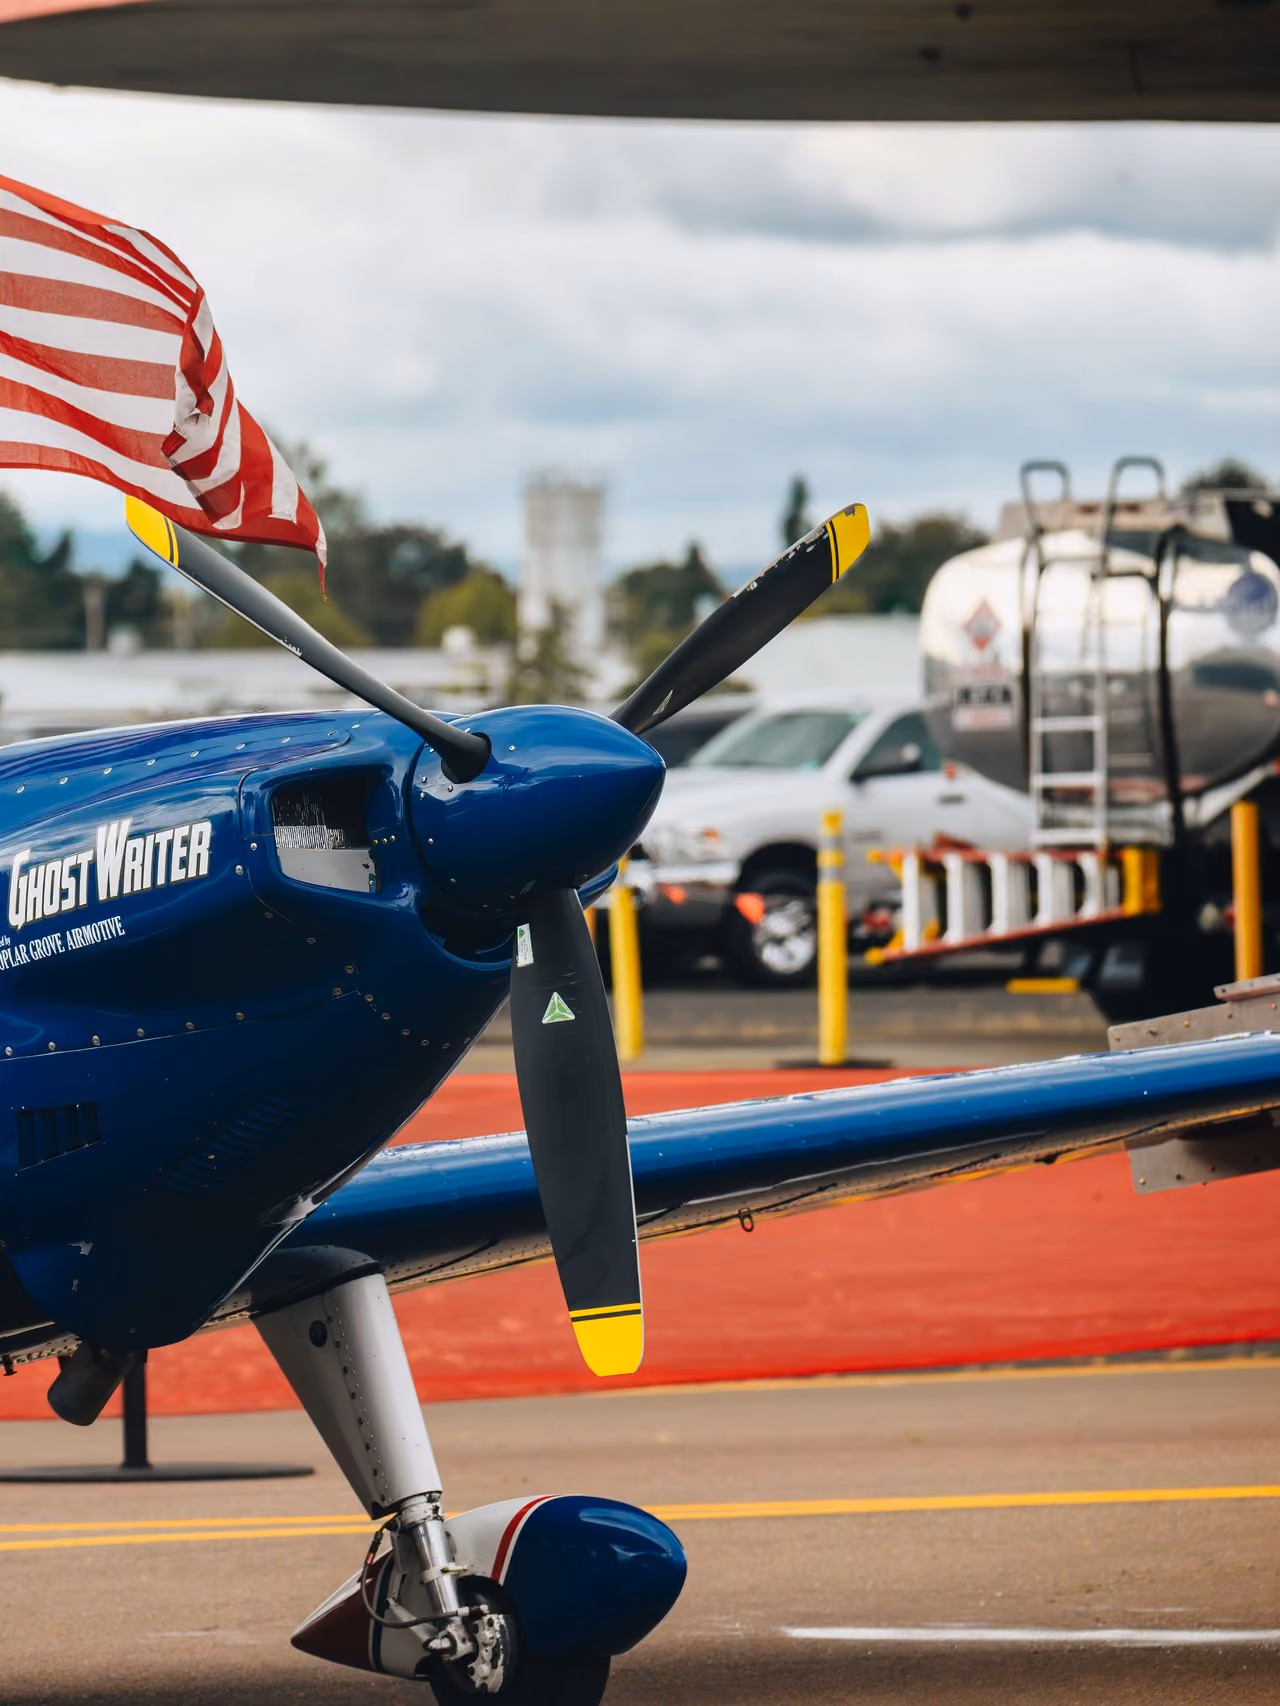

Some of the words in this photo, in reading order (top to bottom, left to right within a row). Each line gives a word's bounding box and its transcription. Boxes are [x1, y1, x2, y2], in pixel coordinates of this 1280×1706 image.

[3, 935, 11, 948] by
[29, 932, 66, 961] GROVE
[67, 915, 126, 951] AIRMOTIVE
